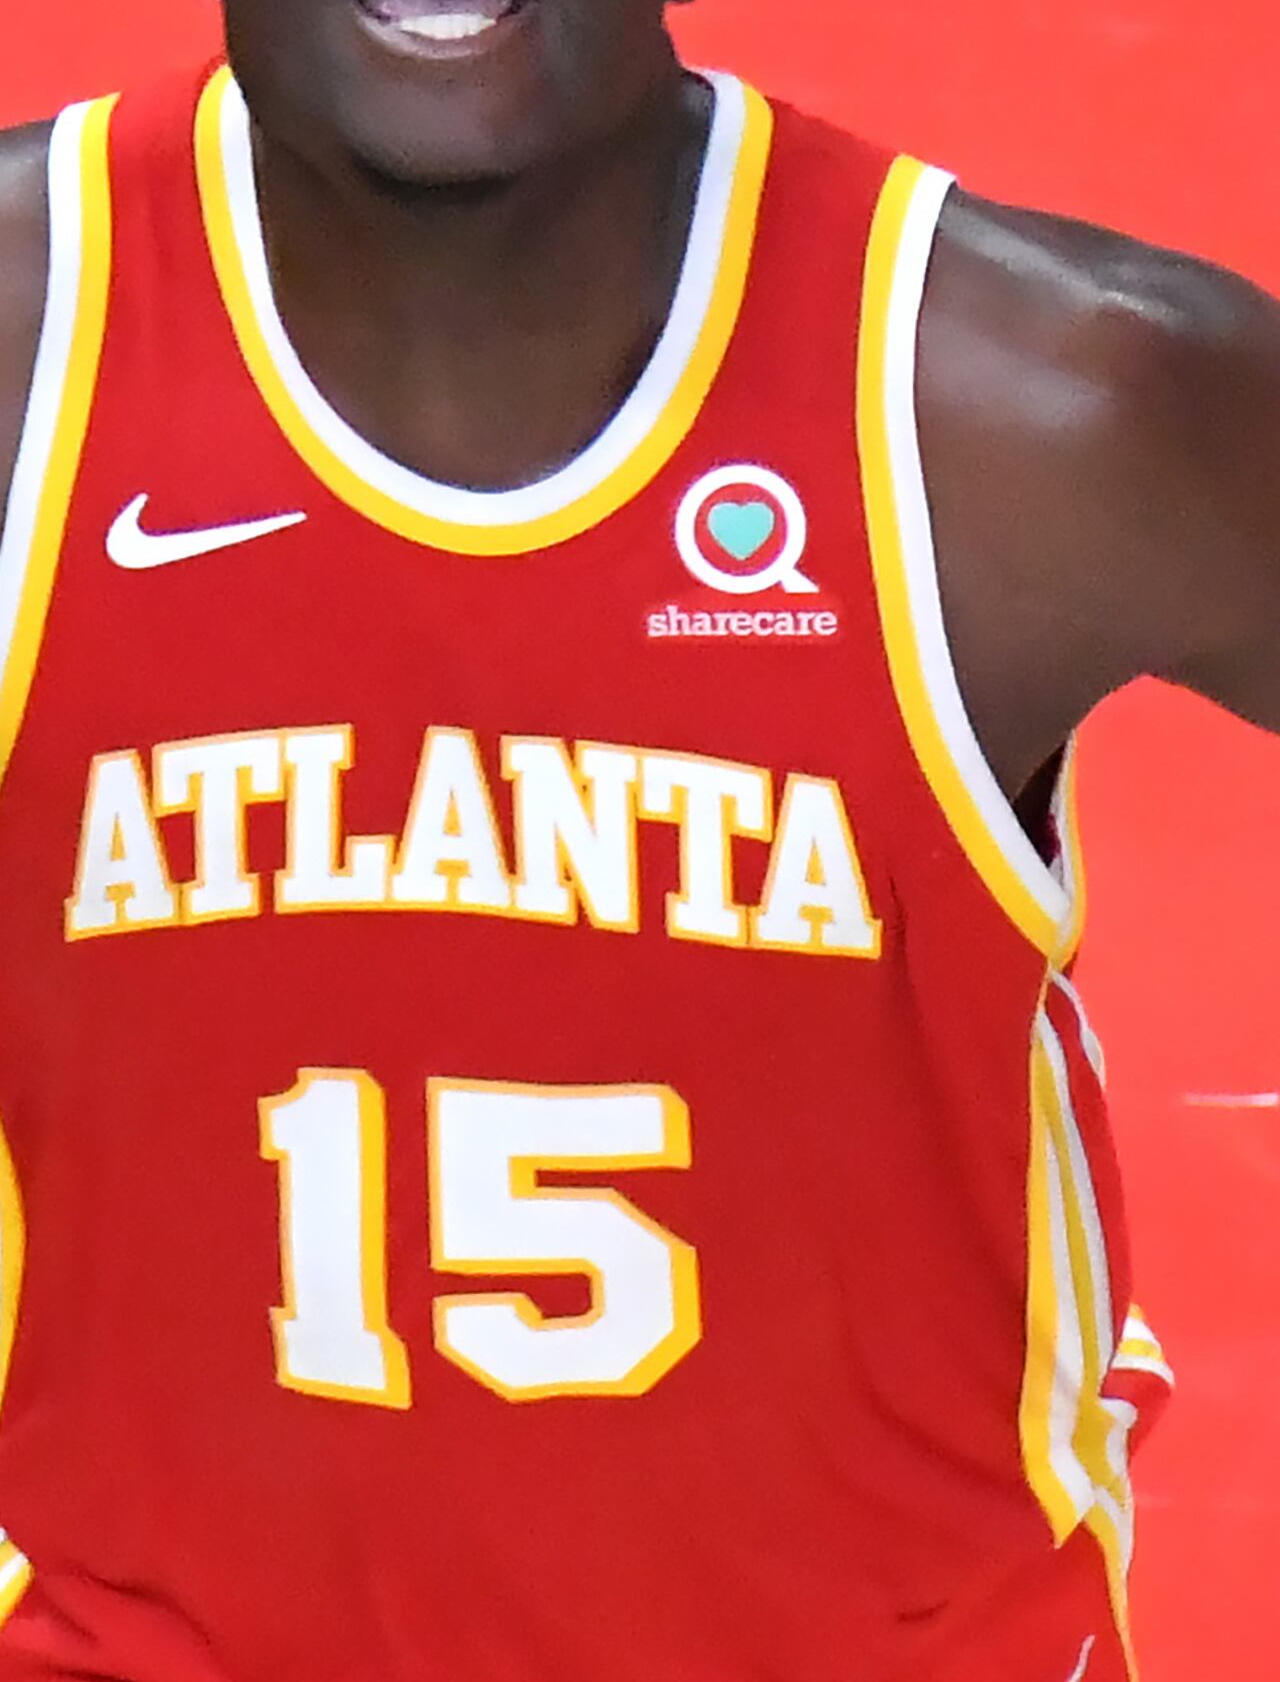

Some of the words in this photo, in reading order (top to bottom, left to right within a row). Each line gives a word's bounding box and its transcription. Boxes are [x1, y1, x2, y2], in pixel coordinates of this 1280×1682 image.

[646, 604, 838, 638] sharecare
[64, 723, 882, 960] ATLANTA
[257, 1066, 703, 1410] 15
